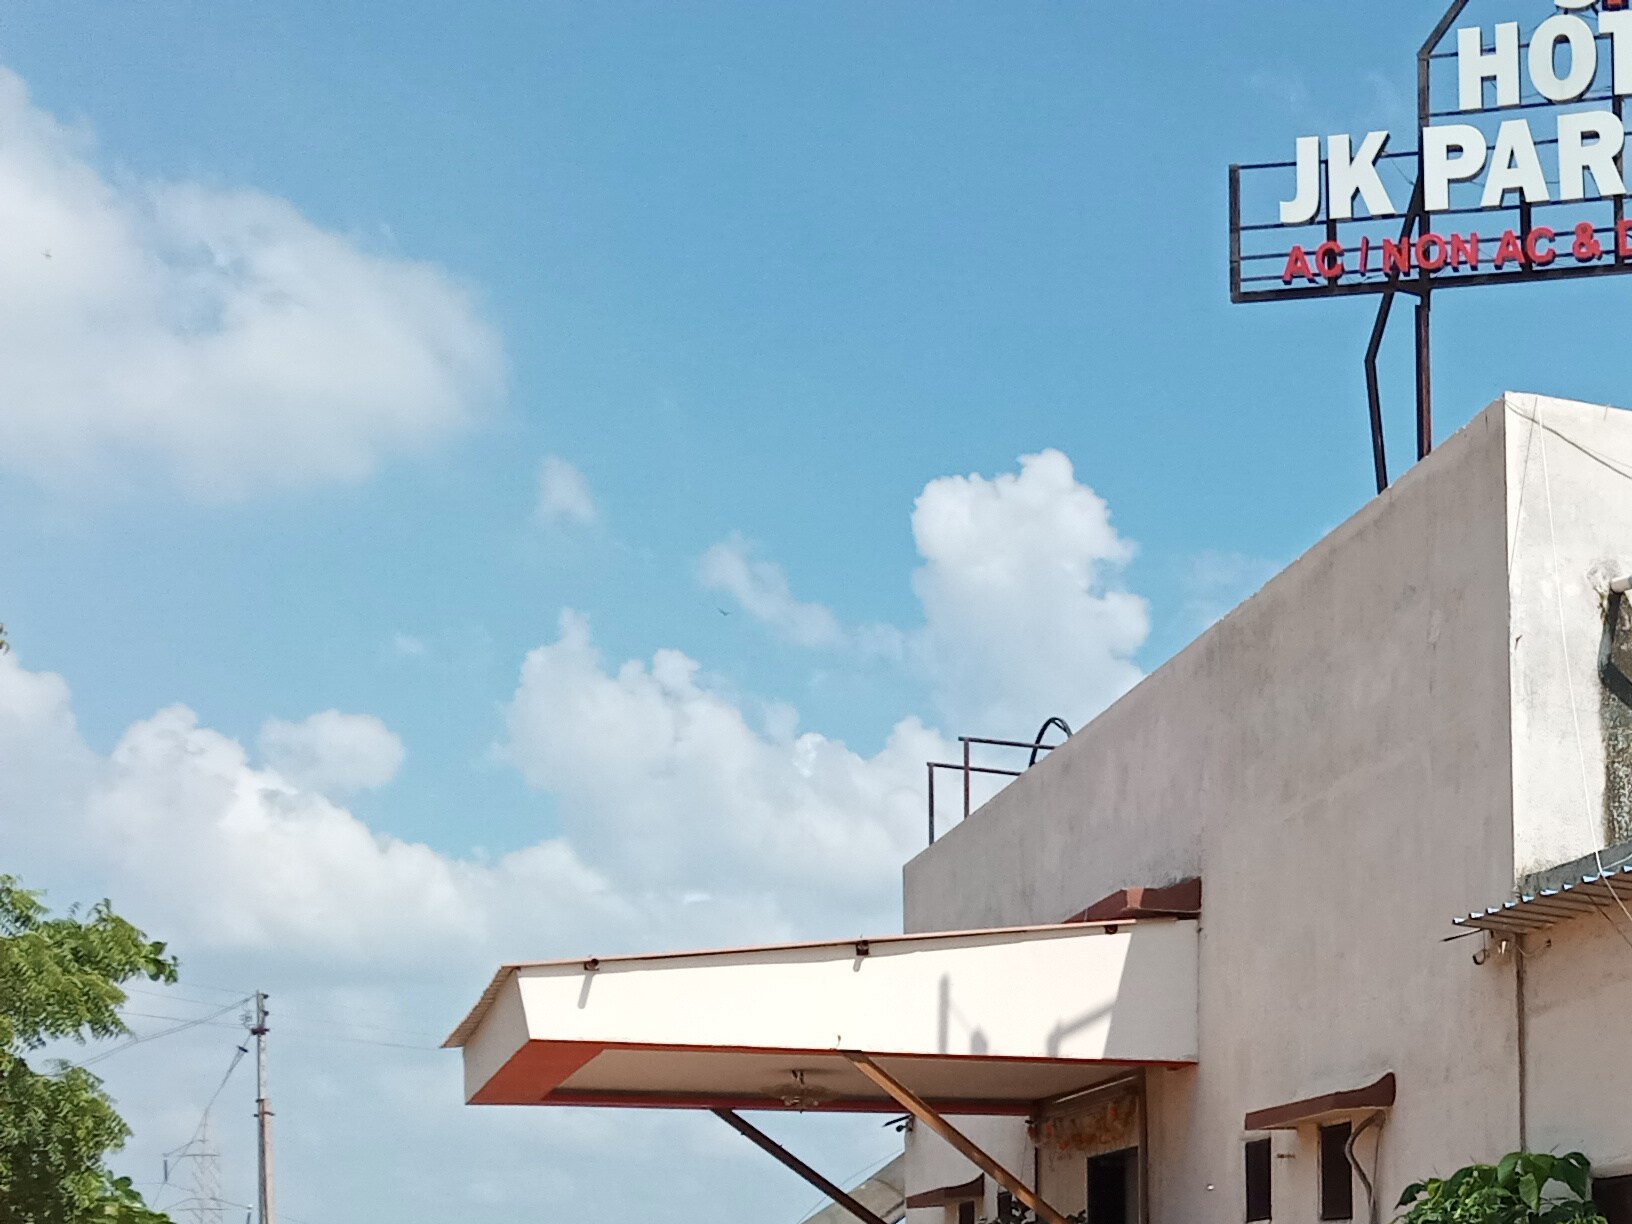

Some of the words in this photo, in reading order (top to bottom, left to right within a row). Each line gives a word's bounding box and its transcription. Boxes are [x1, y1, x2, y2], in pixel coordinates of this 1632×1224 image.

[1279, 130, 1397, 225] JK
[1282, 243, 1345, 284] AC
[1382, 231, 1480, 277] NON
[1493, 226, 1557, 269] AC
[1571, 221, 1602, 264] &
